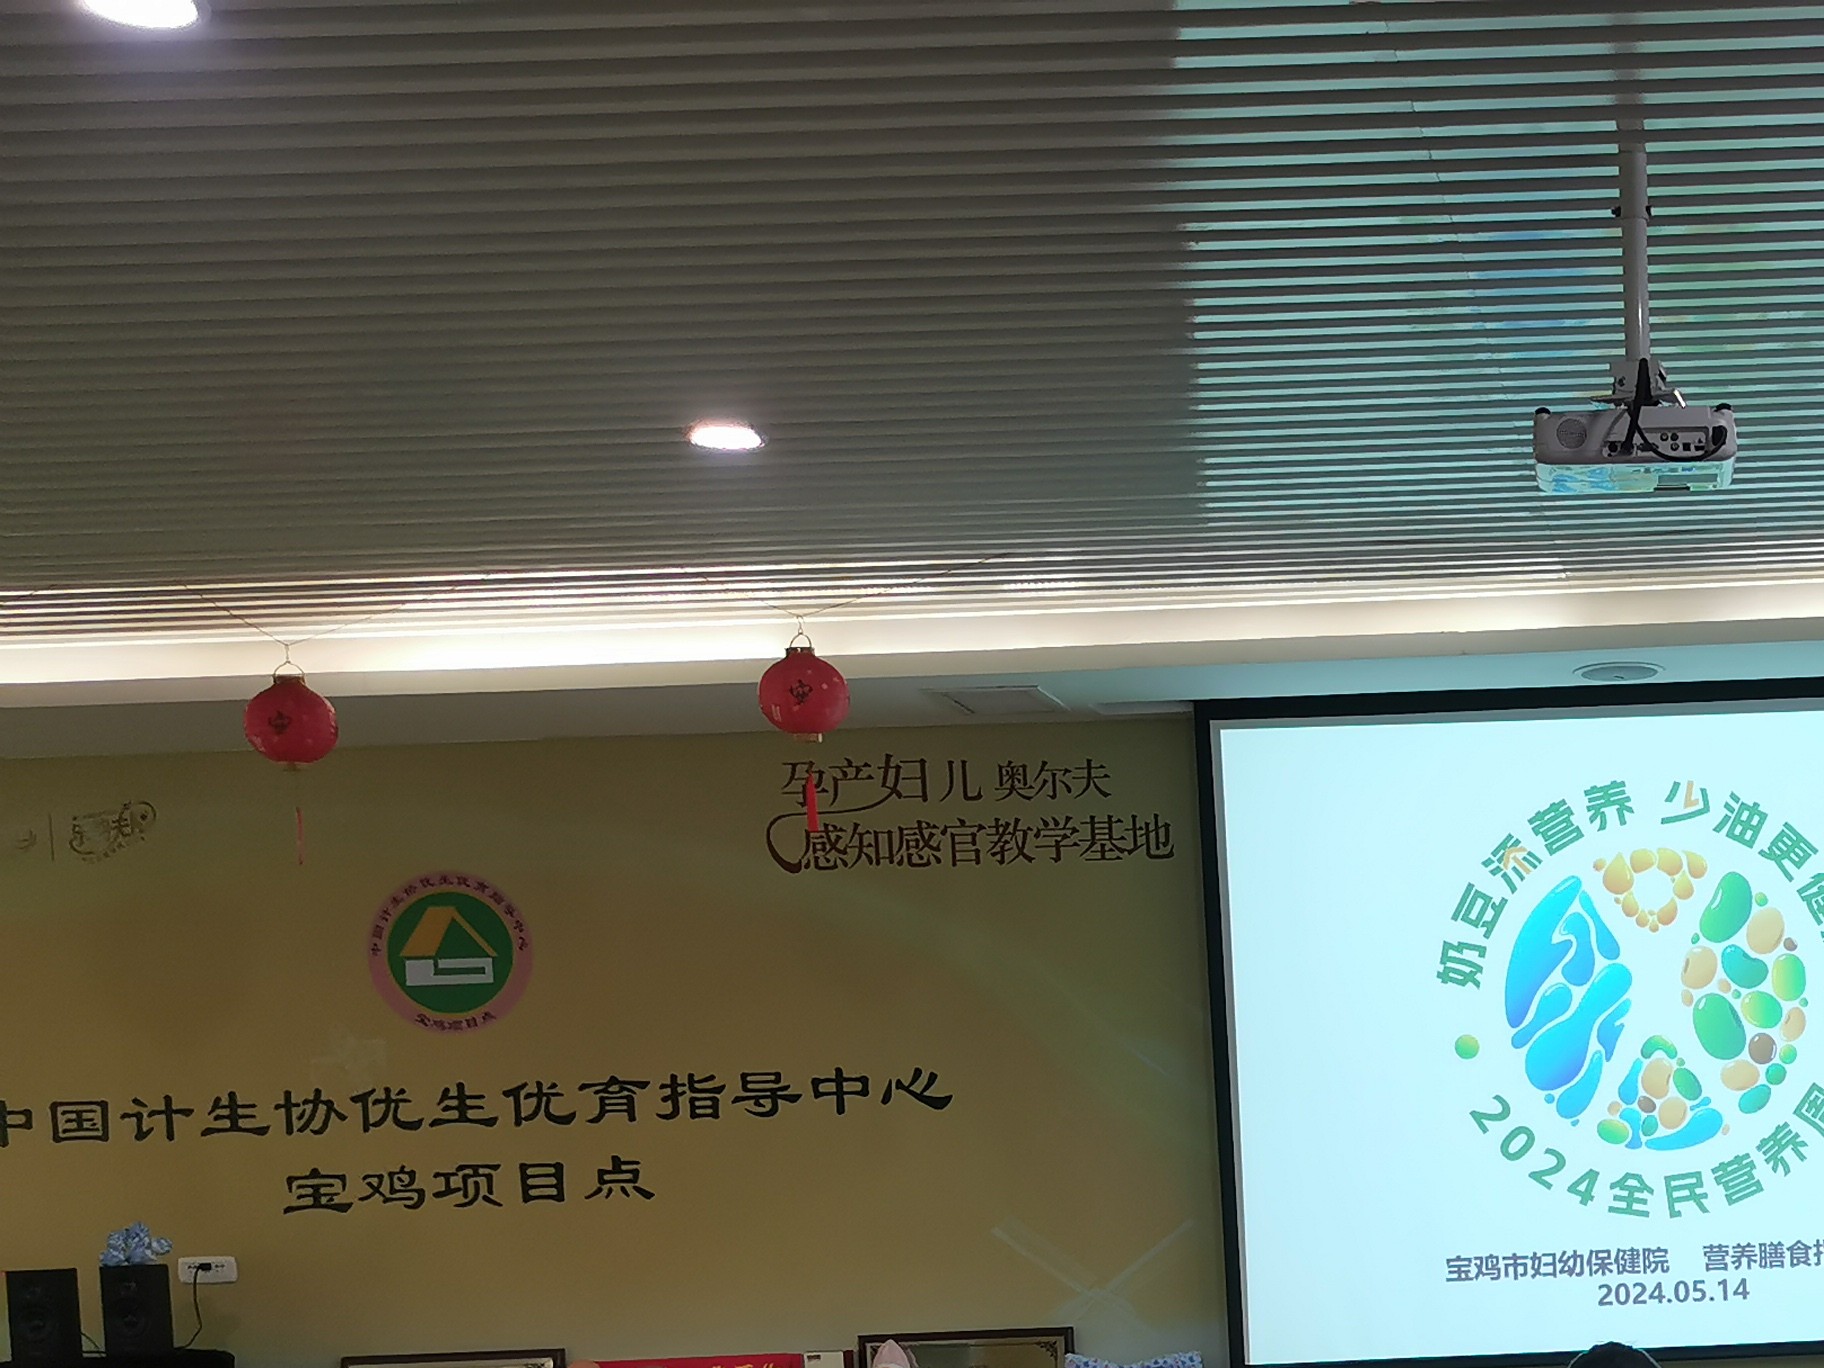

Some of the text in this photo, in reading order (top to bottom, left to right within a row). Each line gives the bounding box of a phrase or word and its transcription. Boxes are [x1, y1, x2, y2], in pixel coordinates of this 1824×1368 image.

[781, 754, 1112, 808] 孕产妇儿 奥尔夫
[801, 812, 1176, 871] 感知感官教学基地
[1436, 779, 1635, 990] 奶豆添营养
[0, 1066, 954, 1148] 中国计生协优生优育指导中心
[282, 1154, 656, 1215] 宝鸡项目点
[1445, 1246, 1670, 1283] 宝鸡市妇幼保健院
[1597, 1278, 1751, 1307] 2024.05.14
